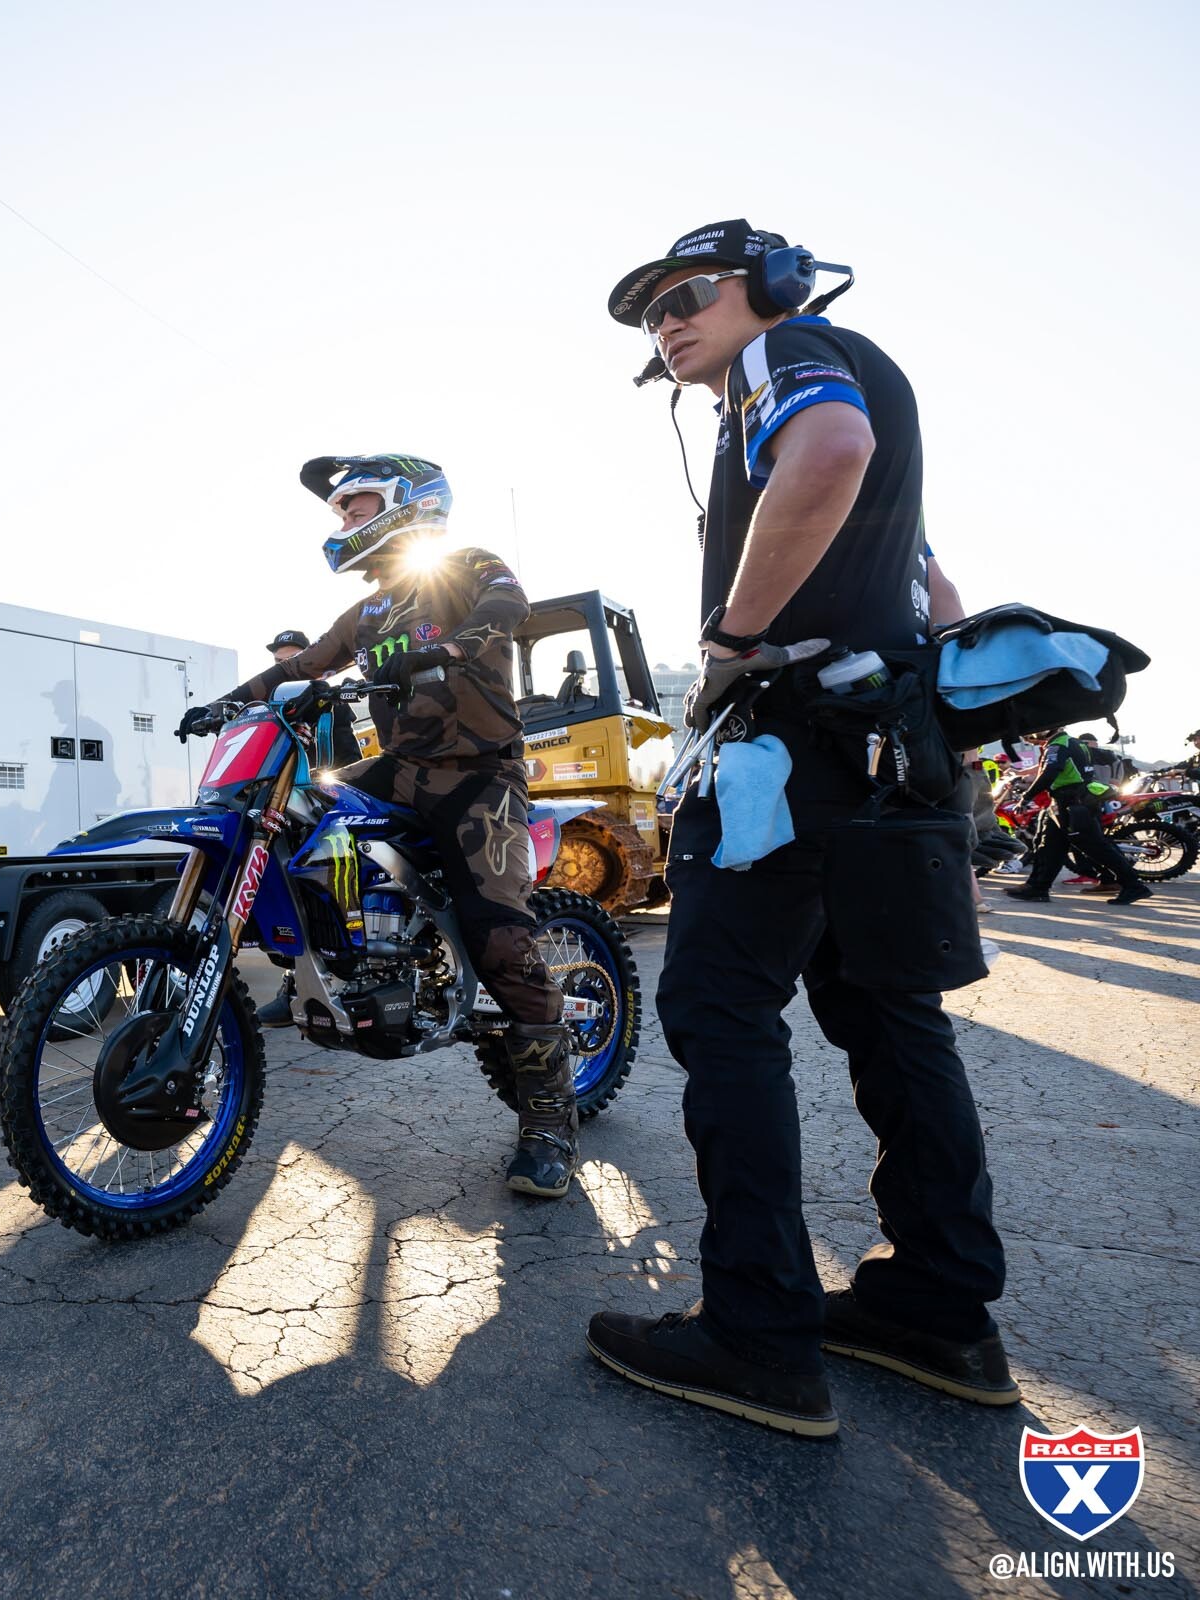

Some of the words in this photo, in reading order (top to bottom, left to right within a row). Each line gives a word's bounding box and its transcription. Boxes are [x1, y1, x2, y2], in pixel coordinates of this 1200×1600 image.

[687, 229, 725, 245] YAMAHA
[765, 386, 824, 430] THOR
[362, 508, 412, 537] MONSTER
[207, 725, 259, 784] 1
[528, 736, 572, 751] YANCEY
[335, 815, 367, 826] YZ
[183, 944, 220, 1037] DUNLOP
[205, 970, 222, 1008] BRAKING
[204, 1121, 245, 1186] DUNLOP
